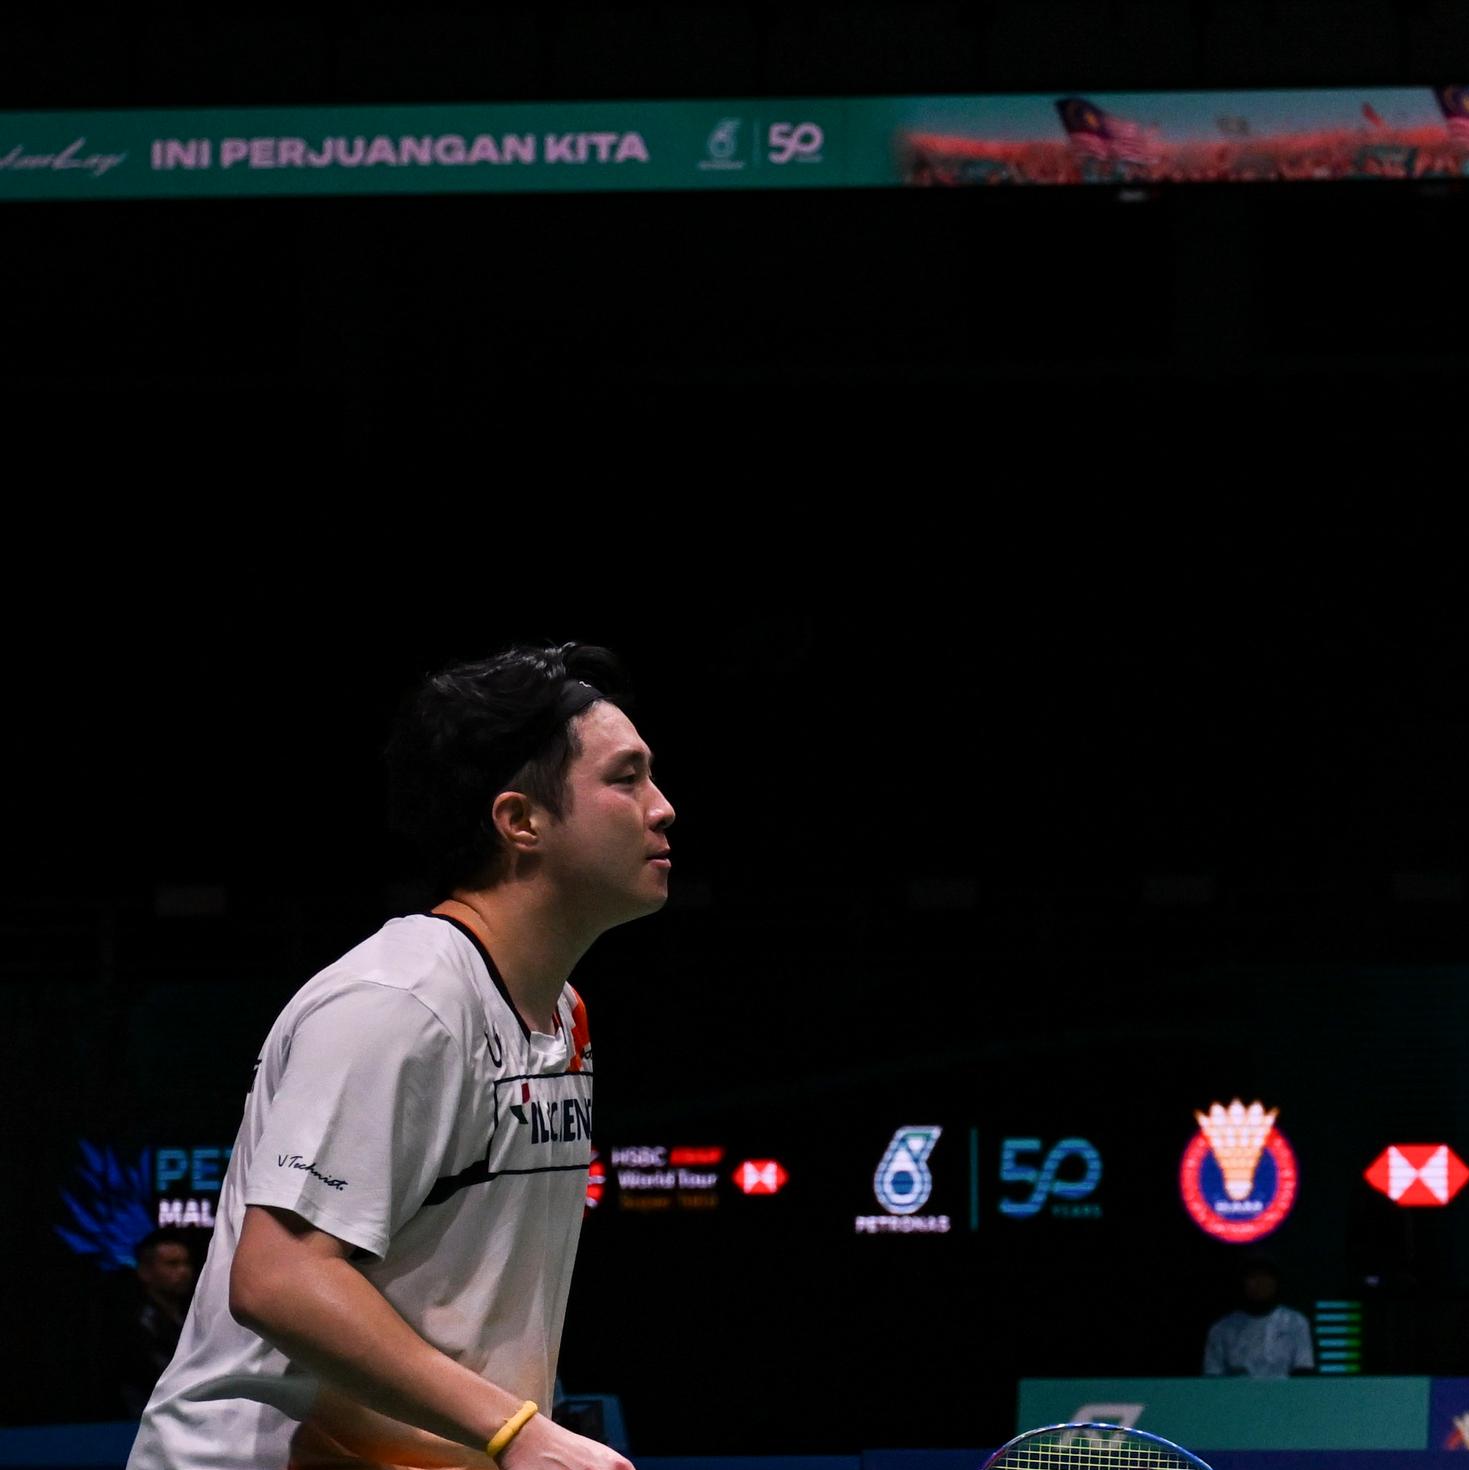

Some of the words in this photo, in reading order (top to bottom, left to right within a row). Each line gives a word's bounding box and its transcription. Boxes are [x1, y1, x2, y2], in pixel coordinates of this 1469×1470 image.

[151, 138, 211, 170] INI
[221, 134, 536, 169] PERJUANGAN
[545, 131, 649, 164] KITA
[768, 122, 824, 164] 50
[999, 1136, 1103, 1220] 50
